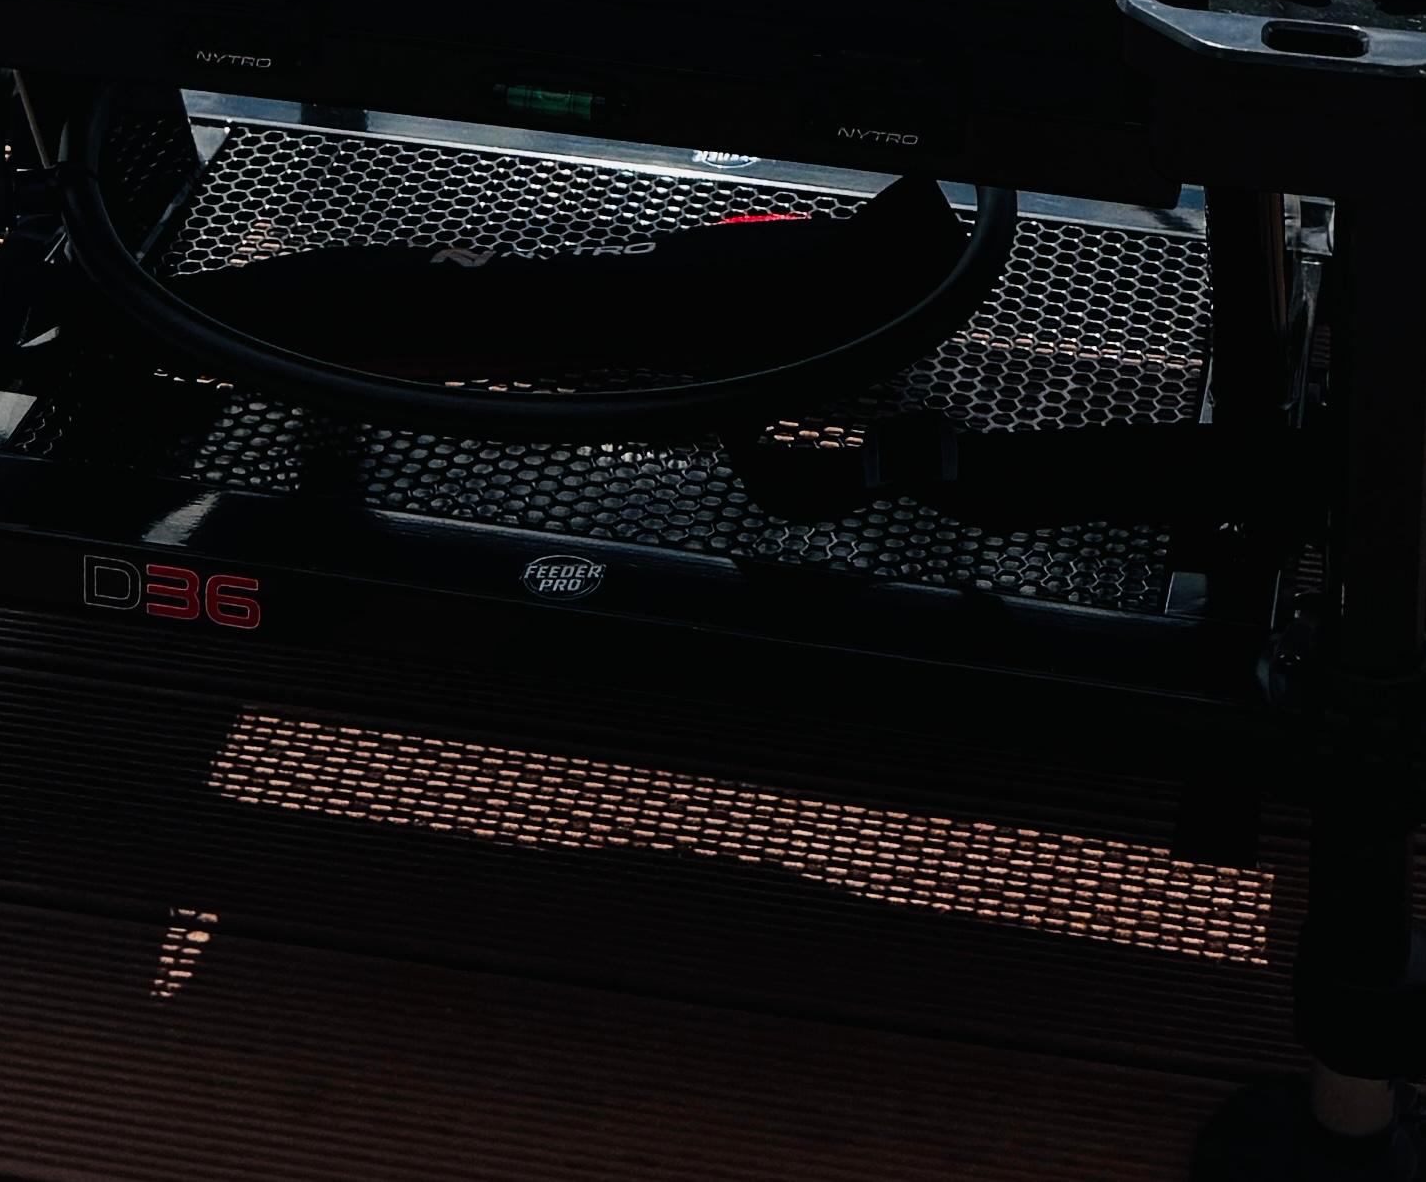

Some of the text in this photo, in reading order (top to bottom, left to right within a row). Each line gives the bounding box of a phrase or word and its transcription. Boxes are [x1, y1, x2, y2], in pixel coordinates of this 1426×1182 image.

[195, 49, 273, 69] NYTRO
[837, 126, 920, 146] NYTRO
[524, 562, 604, 582] FEEDER
[83, 554, 262, 630] D36
[538, 577, 584, 593] PRO
